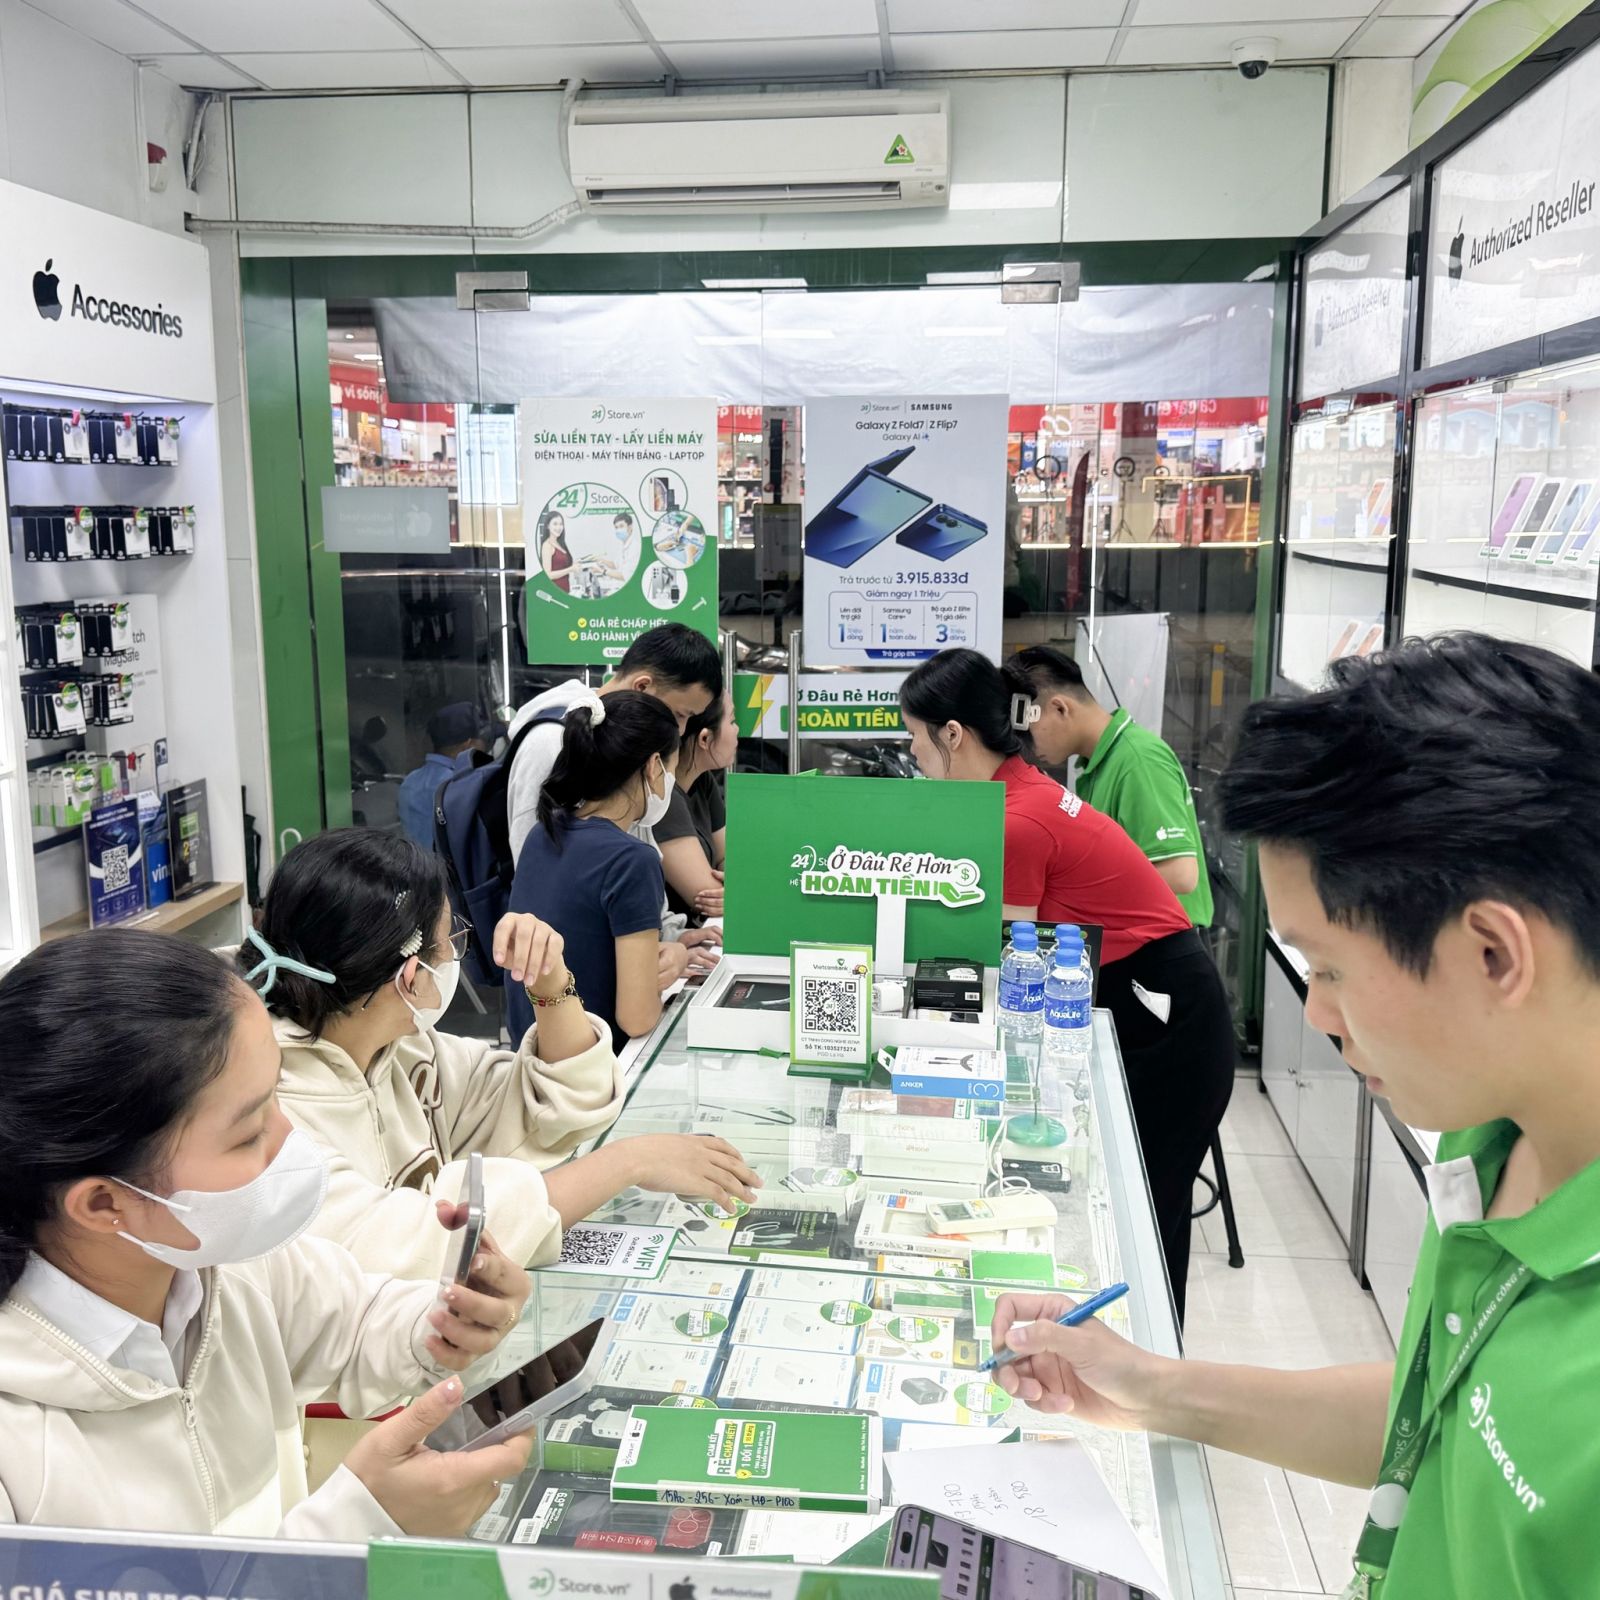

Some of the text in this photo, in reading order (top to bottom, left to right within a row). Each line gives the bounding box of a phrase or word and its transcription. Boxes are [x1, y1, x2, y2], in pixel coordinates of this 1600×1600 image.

[1469, 179, 1595, 268] Authorized Reseller
[71, 284, 183, 338] Accessories
[608, 410, 643, 419] Store.vn
[856, 421, 890, 431] Galaxy
[892, 421, 897, 429] Z
[899, 421, 924, 429] Fold7
[937, 420, 958, 431] Flip7
[534, 429, 557, 444] SỬA
[591, 434, 612, 444] TAY
[623, 429, 644, 444] LẤY
[678, 430, 703, 444] MÁY
[883, 433, 911, 442] Galaxy
[558, 452, 584, 462] THOẠI
[592, 450, 611, 460] MÁY
[614, 450, 634, 460] TÍNH
[670, 452, 704, 460] LAPTOP
[896, 572, 969, 584] 3.915.833đ
[891, 591, 912, 599] ngay
[589, 618, 605, 628] GIÁ
[132, 630, 145, 642] tch
[602, 630, 629, 641] HÀNH
[936, 624, 948, 643] 3
[808, 690, 838, 701] Đâu
[843, 689, 862, 701] Rẻ
[868, 690, 898, 701] Hơn
[853, 707, 898, 727] TIỀN
[831, 849, 845, 869] Ở
[890, 855, 912, 872] Rẻ
[916, 856, 952, 874] Hơn
[805, 873, 872, 893] HOÀN
[1049, 1008, 1081, 1019] AquaLife
[633, 1245, 660, 1270] WIFI
[1481, 1416, 1537, 1514] Store.vn
[695, 1491, 713, 1504] 256
[559, 1578, 627, 1595] Store.vn
[711, 1586, 772, 1598] Authorized
